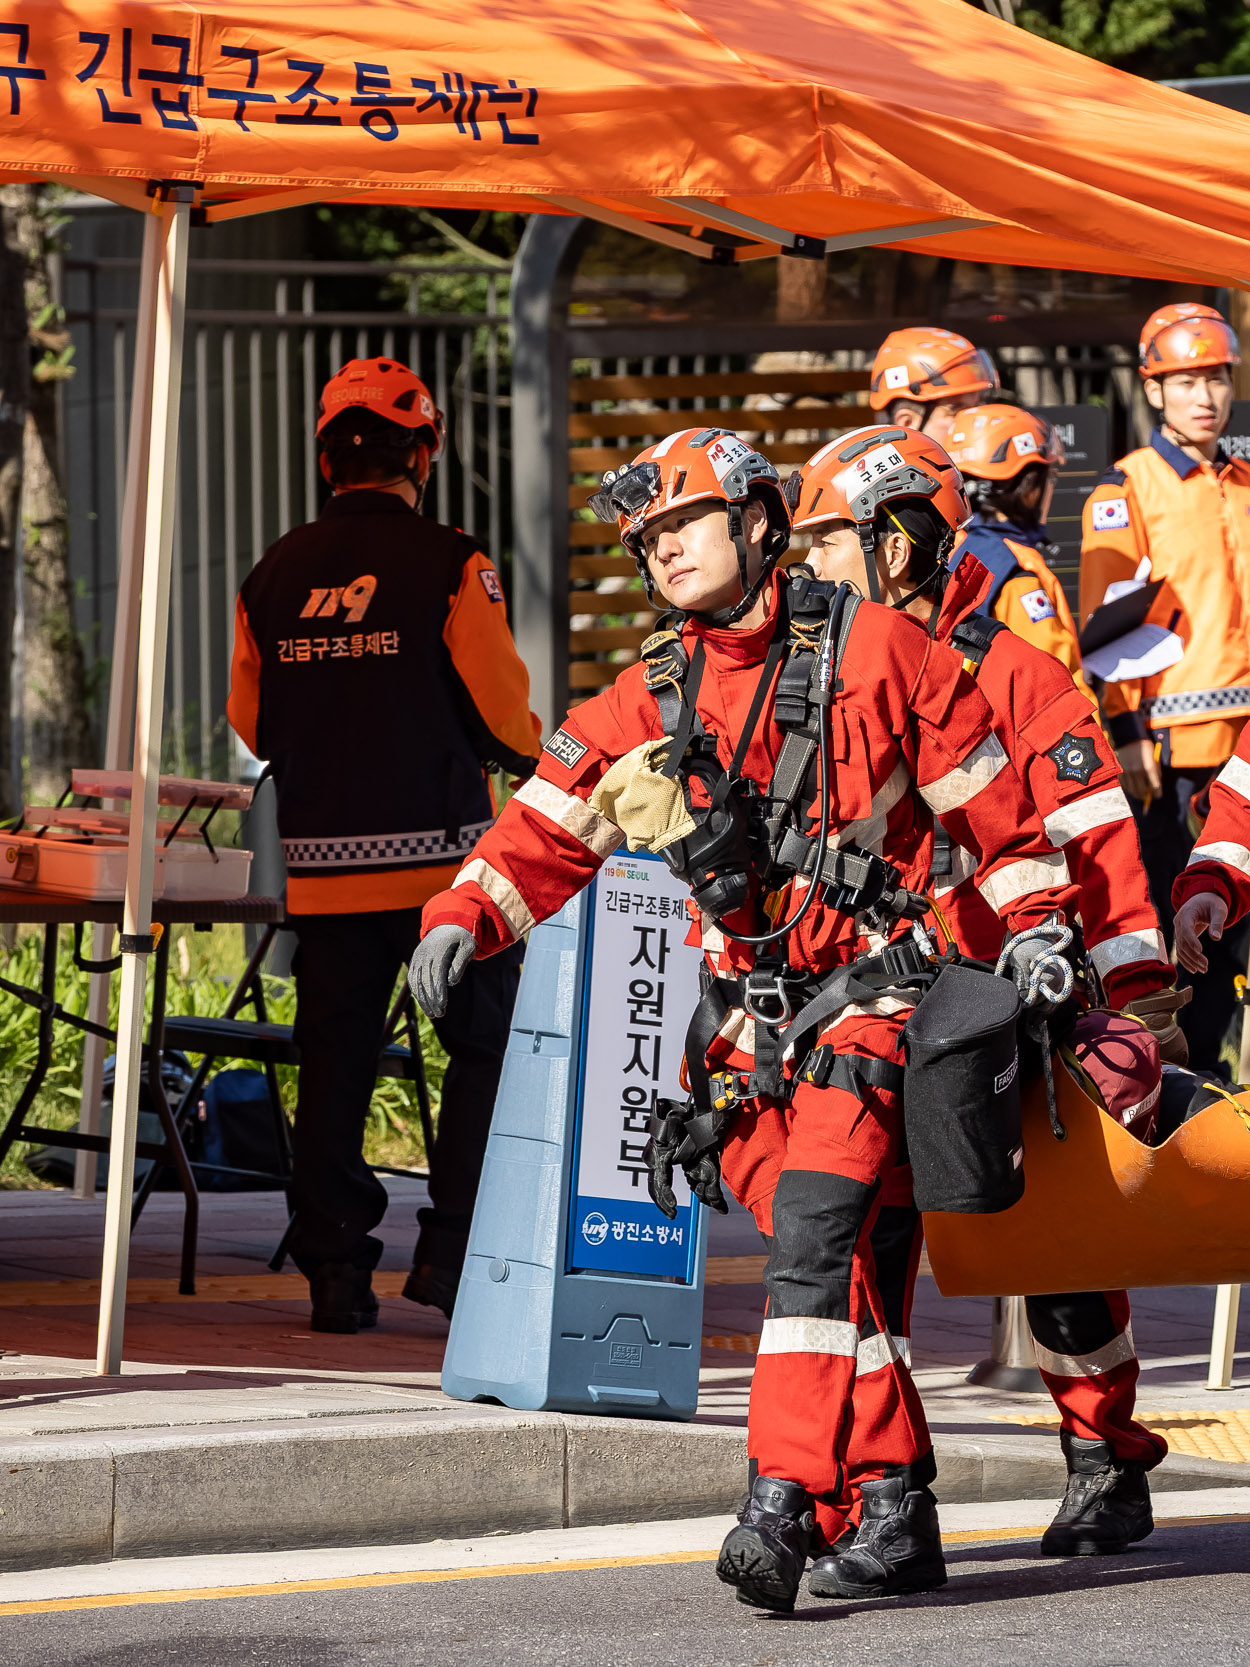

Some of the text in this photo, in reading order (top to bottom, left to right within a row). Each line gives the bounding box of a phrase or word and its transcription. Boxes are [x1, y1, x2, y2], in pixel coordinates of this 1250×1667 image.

[76, 27, 540, 145] 긴급구조통제단
[362, 386, 385, 401] FIRE
[711, 444, 726, 461] 119
[860, 453, 902, 483] 구조대
[299, 574, 378, 624] 119
[277, 630, 400, 663] 긴급구조통제단
[604, 866, 650, 881] 119 ON SEOUL
[617, 925, 671, 1188] 자원지원부
[611, 1220, 684, 1246] 광진소방서
